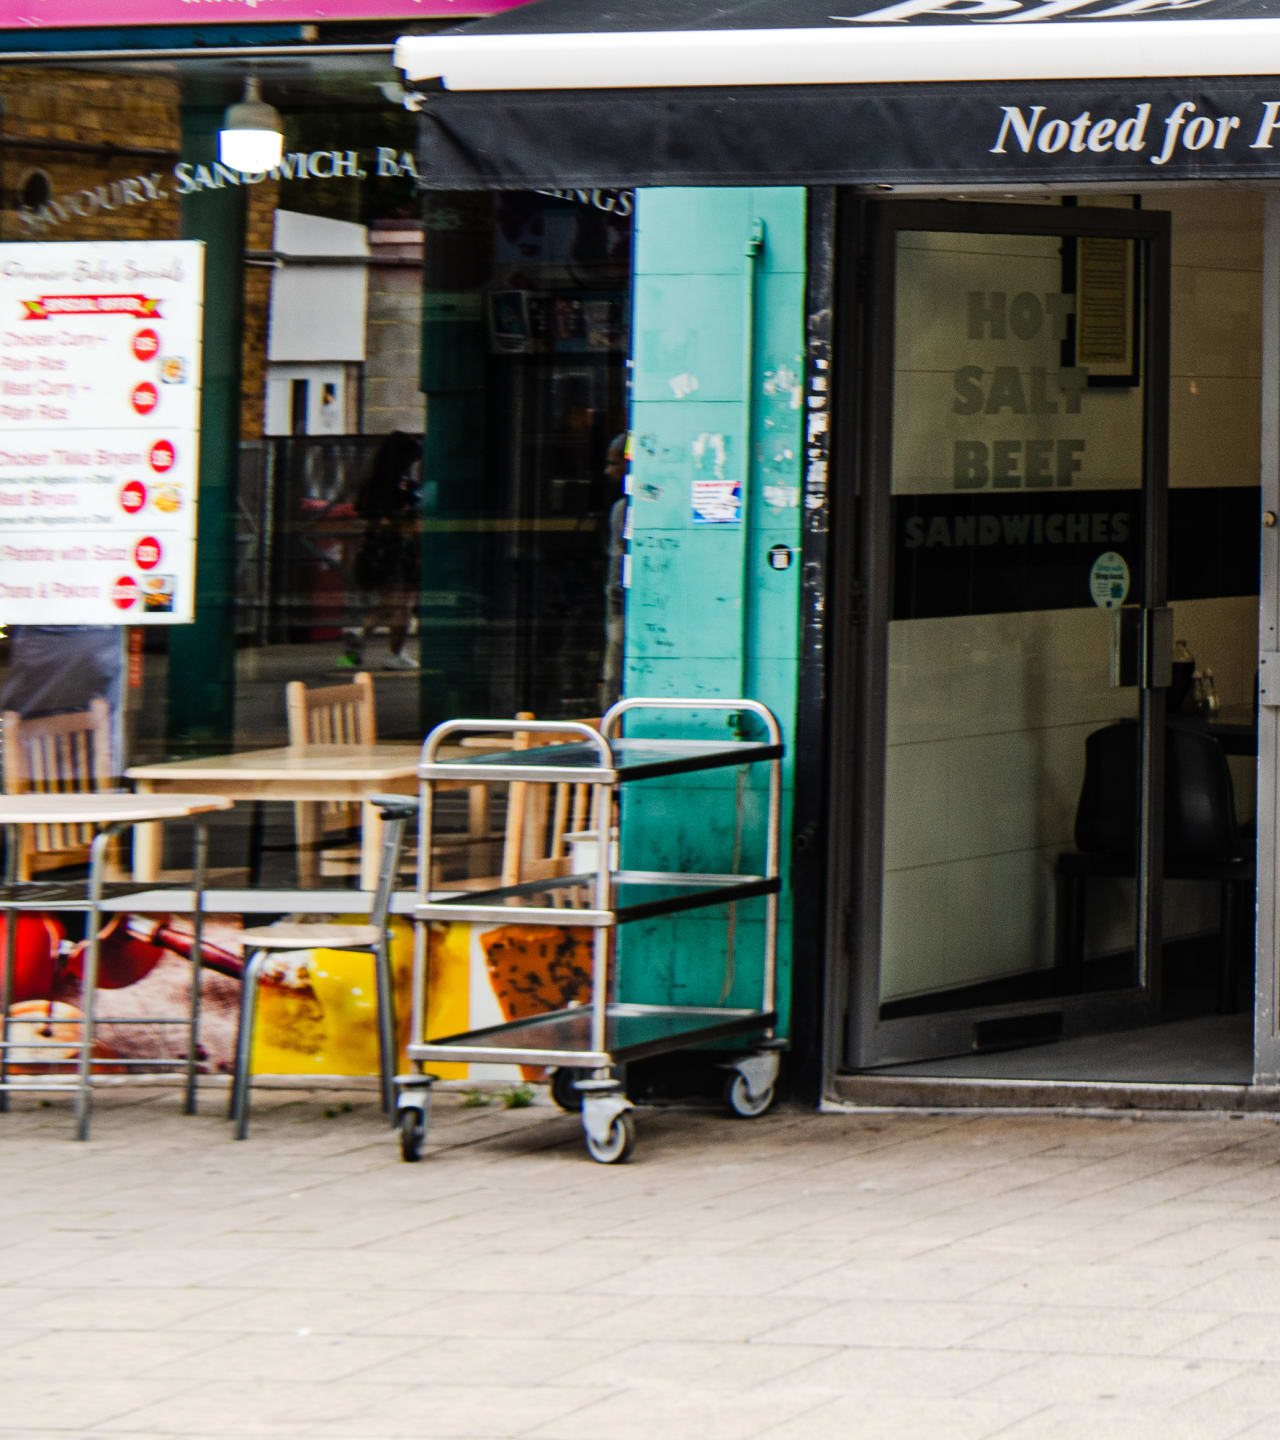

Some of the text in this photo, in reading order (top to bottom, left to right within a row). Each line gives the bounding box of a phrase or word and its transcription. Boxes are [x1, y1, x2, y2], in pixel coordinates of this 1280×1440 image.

[990, 102, 1150, 154] Noted
[1151, 101, 1239, 164] for
[967, 291, 1076, 340] HOT
[951, 366, 1089, 415] SALT
[953, 440, 1085, 490] BEEF
[904, 512, 1131, 548] SANDWICHES
